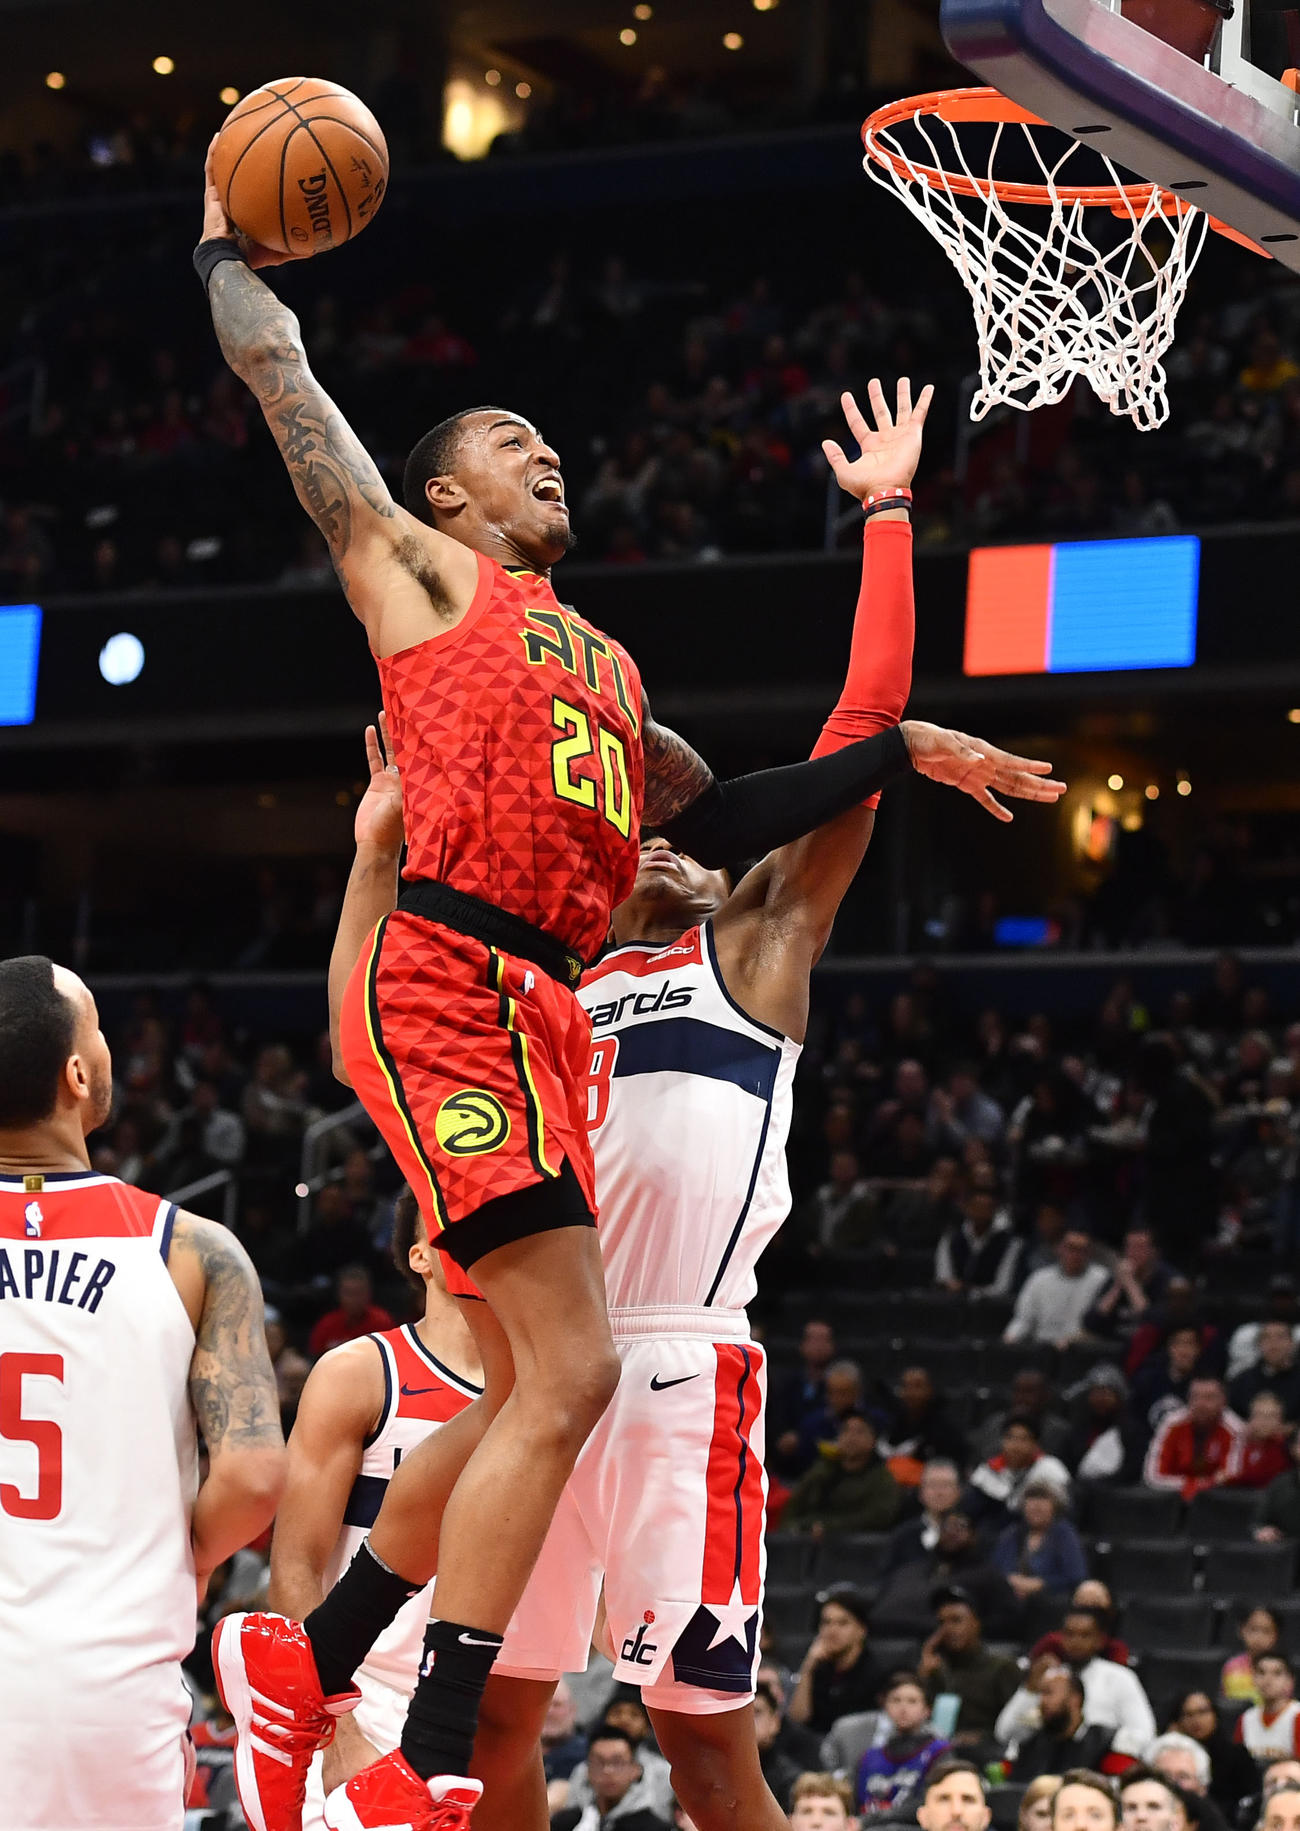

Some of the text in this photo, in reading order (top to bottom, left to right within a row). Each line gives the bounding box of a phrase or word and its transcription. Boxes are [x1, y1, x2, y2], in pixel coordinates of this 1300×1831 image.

[518, 607, 638, 739] ATL
[551, 694, 631, 841] 20
[0, 1248, 116, 1315] APIER
[0, 1352, 64, 1521] 5
[621, 1624, 657, 1665] dc
